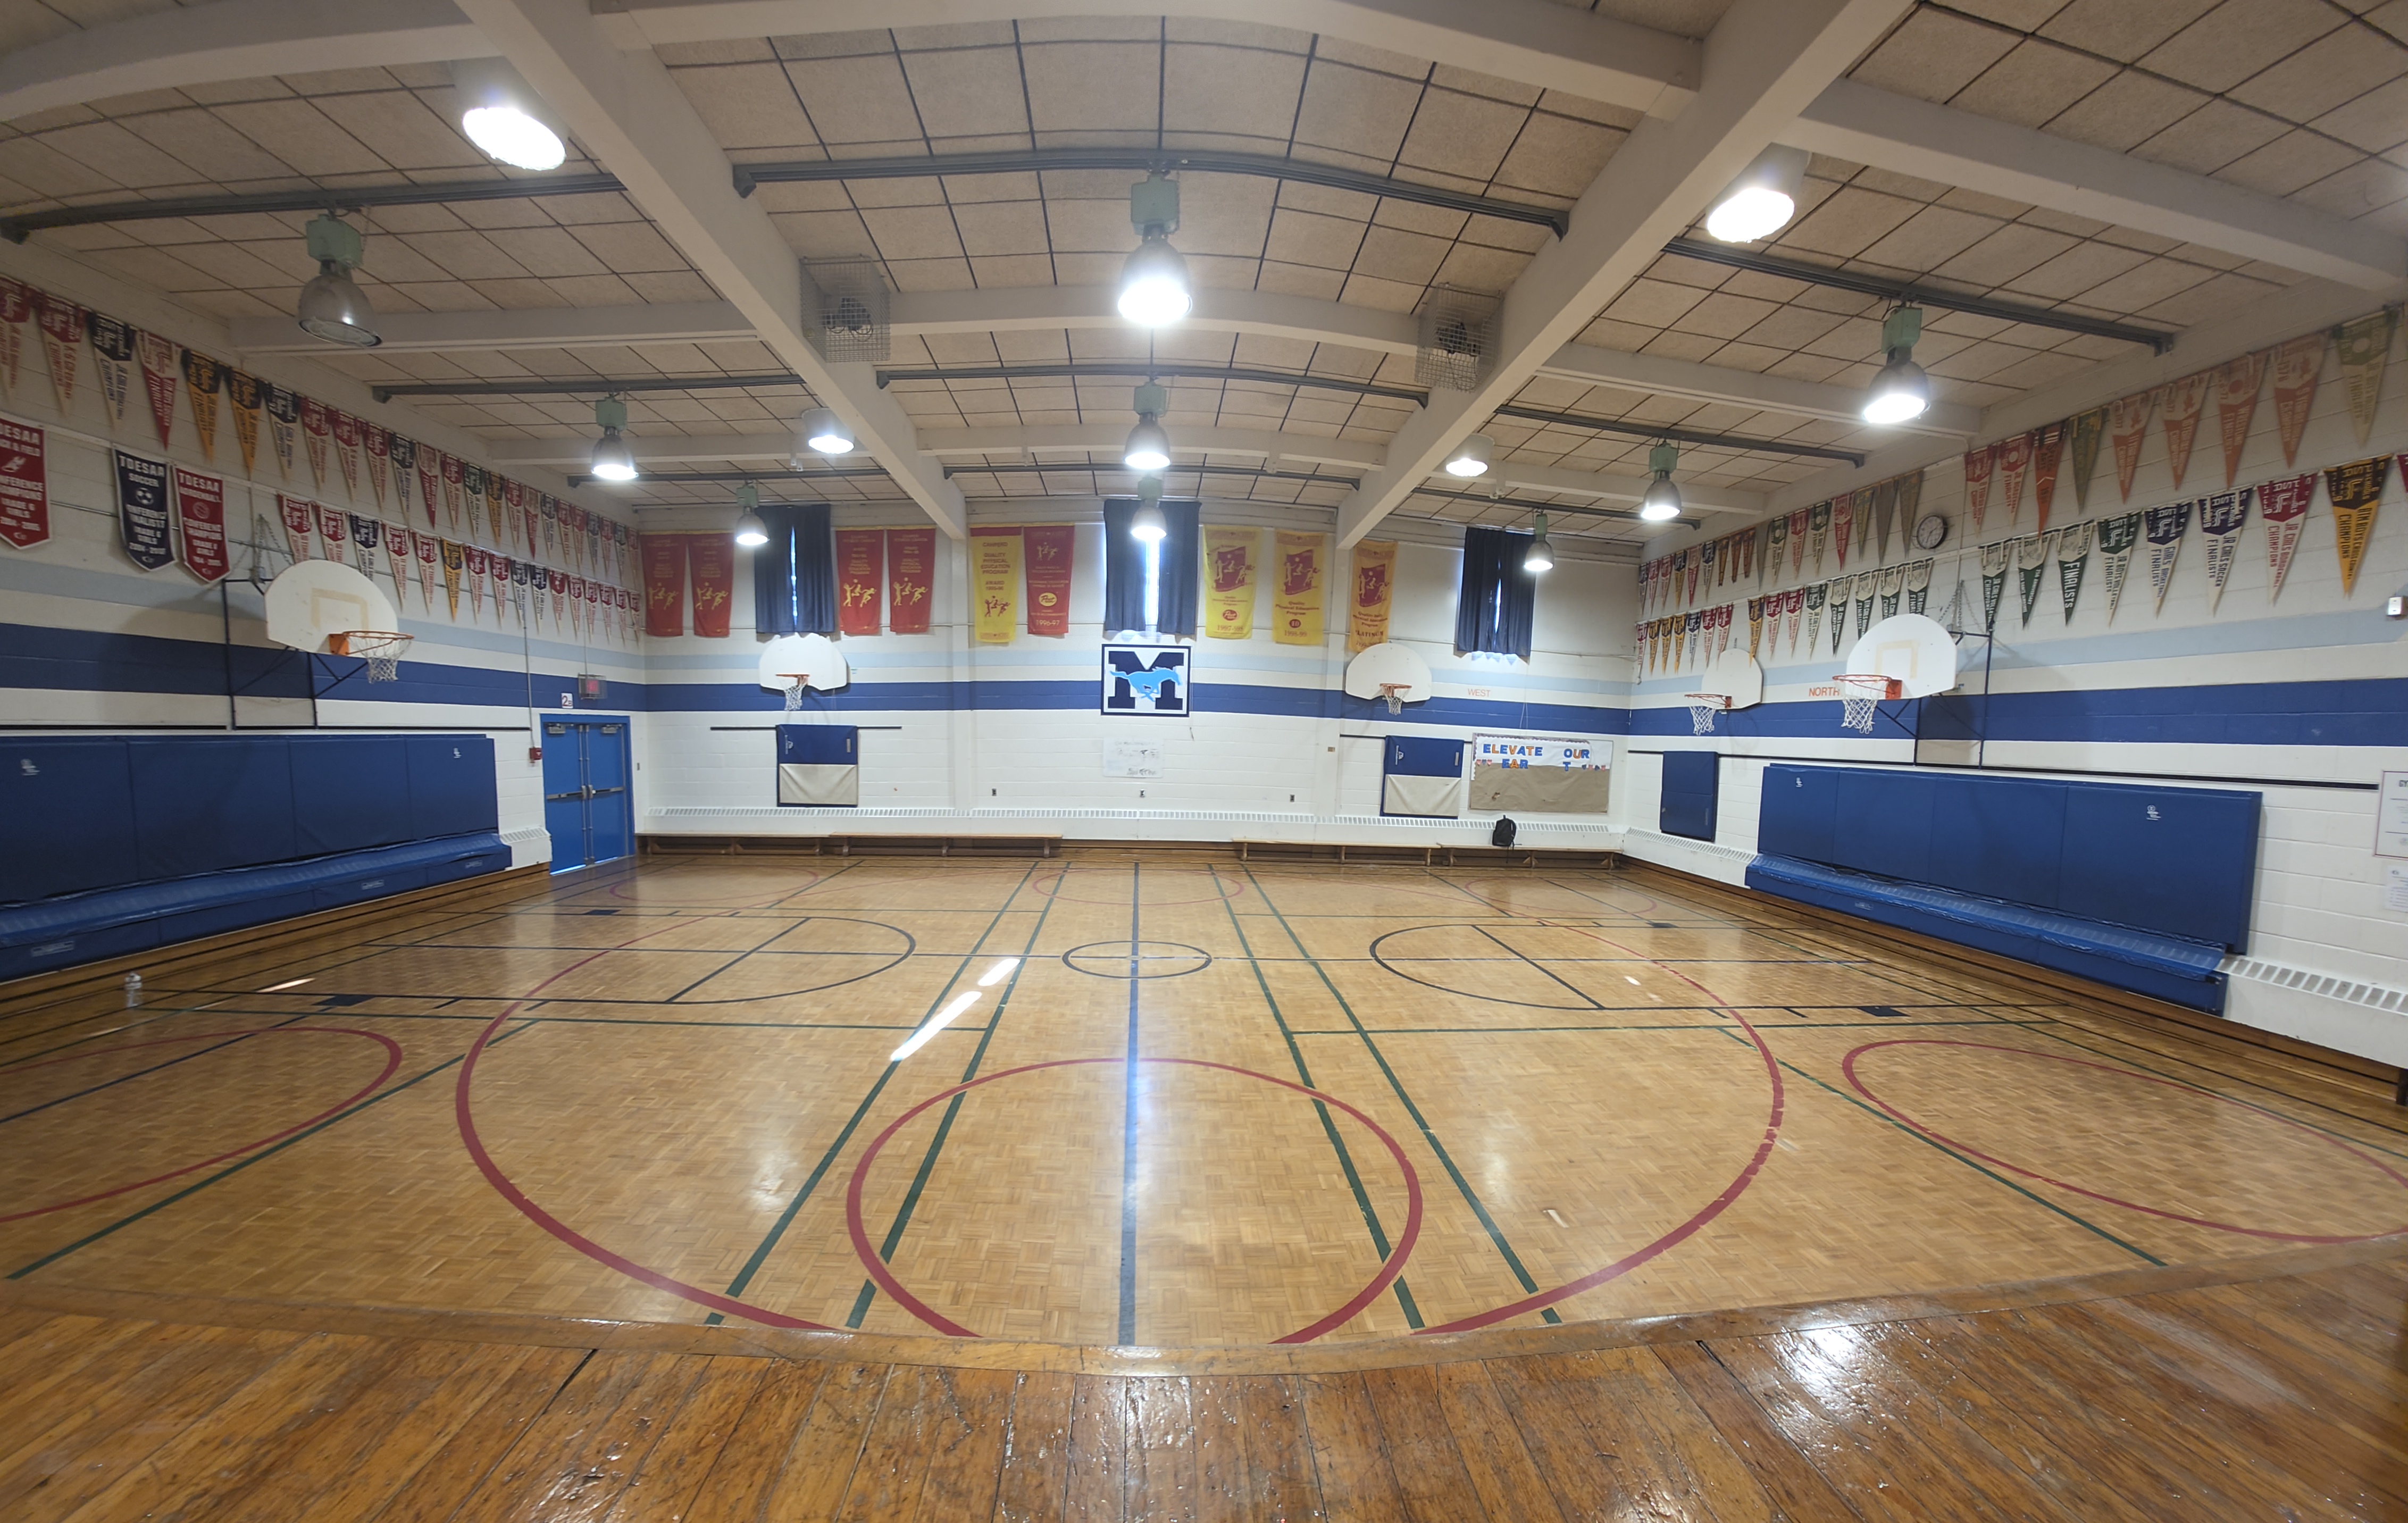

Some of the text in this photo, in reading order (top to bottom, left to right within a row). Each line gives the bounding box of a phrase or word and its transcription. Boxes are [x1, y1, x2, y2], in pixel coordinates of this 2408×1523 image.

[148, 375, 163, 417] FINALISTS
[2348, 374, 2363, 419] FINALISTS
[0, 424, 39, 445] ESAA
[119, 455, 165, 478] TDESAA
[129, 473, 159, 487] SOCCER
[179, 473, 220, 492] TDESAA
[2282, 533, 2296, 551] GIRLS
[2338, 514, 2352, 558] CHAMPIONS
[2353, 522, 2368, 541] BOYS
[2163, 546, 2176, 565] GIRLS
[2220, 545, 2234, 562] GIRLS
[2268, 525, 2280, 567] CHAMPIONS
[2151, 549, 2162, 587] FINALISTS
[2206, 539, 2219, 578] FINALISTS
[2105, 557, 2114, 592] FINALISTS
[2114, 564, 2126, 580] BOYS
[2215, 563, 2228, 587] SOCCER
[2064, 562, 2080, 608] FINALISTS
[1108, 651, 1184, 710] M
[1809, 687, 1840, 697] NORTH
[1483, 743, 1590, 759] ELEVATE OUR
[1502, 758, 1529, 769] EAR
[1562, 761, 1571, 772] T
